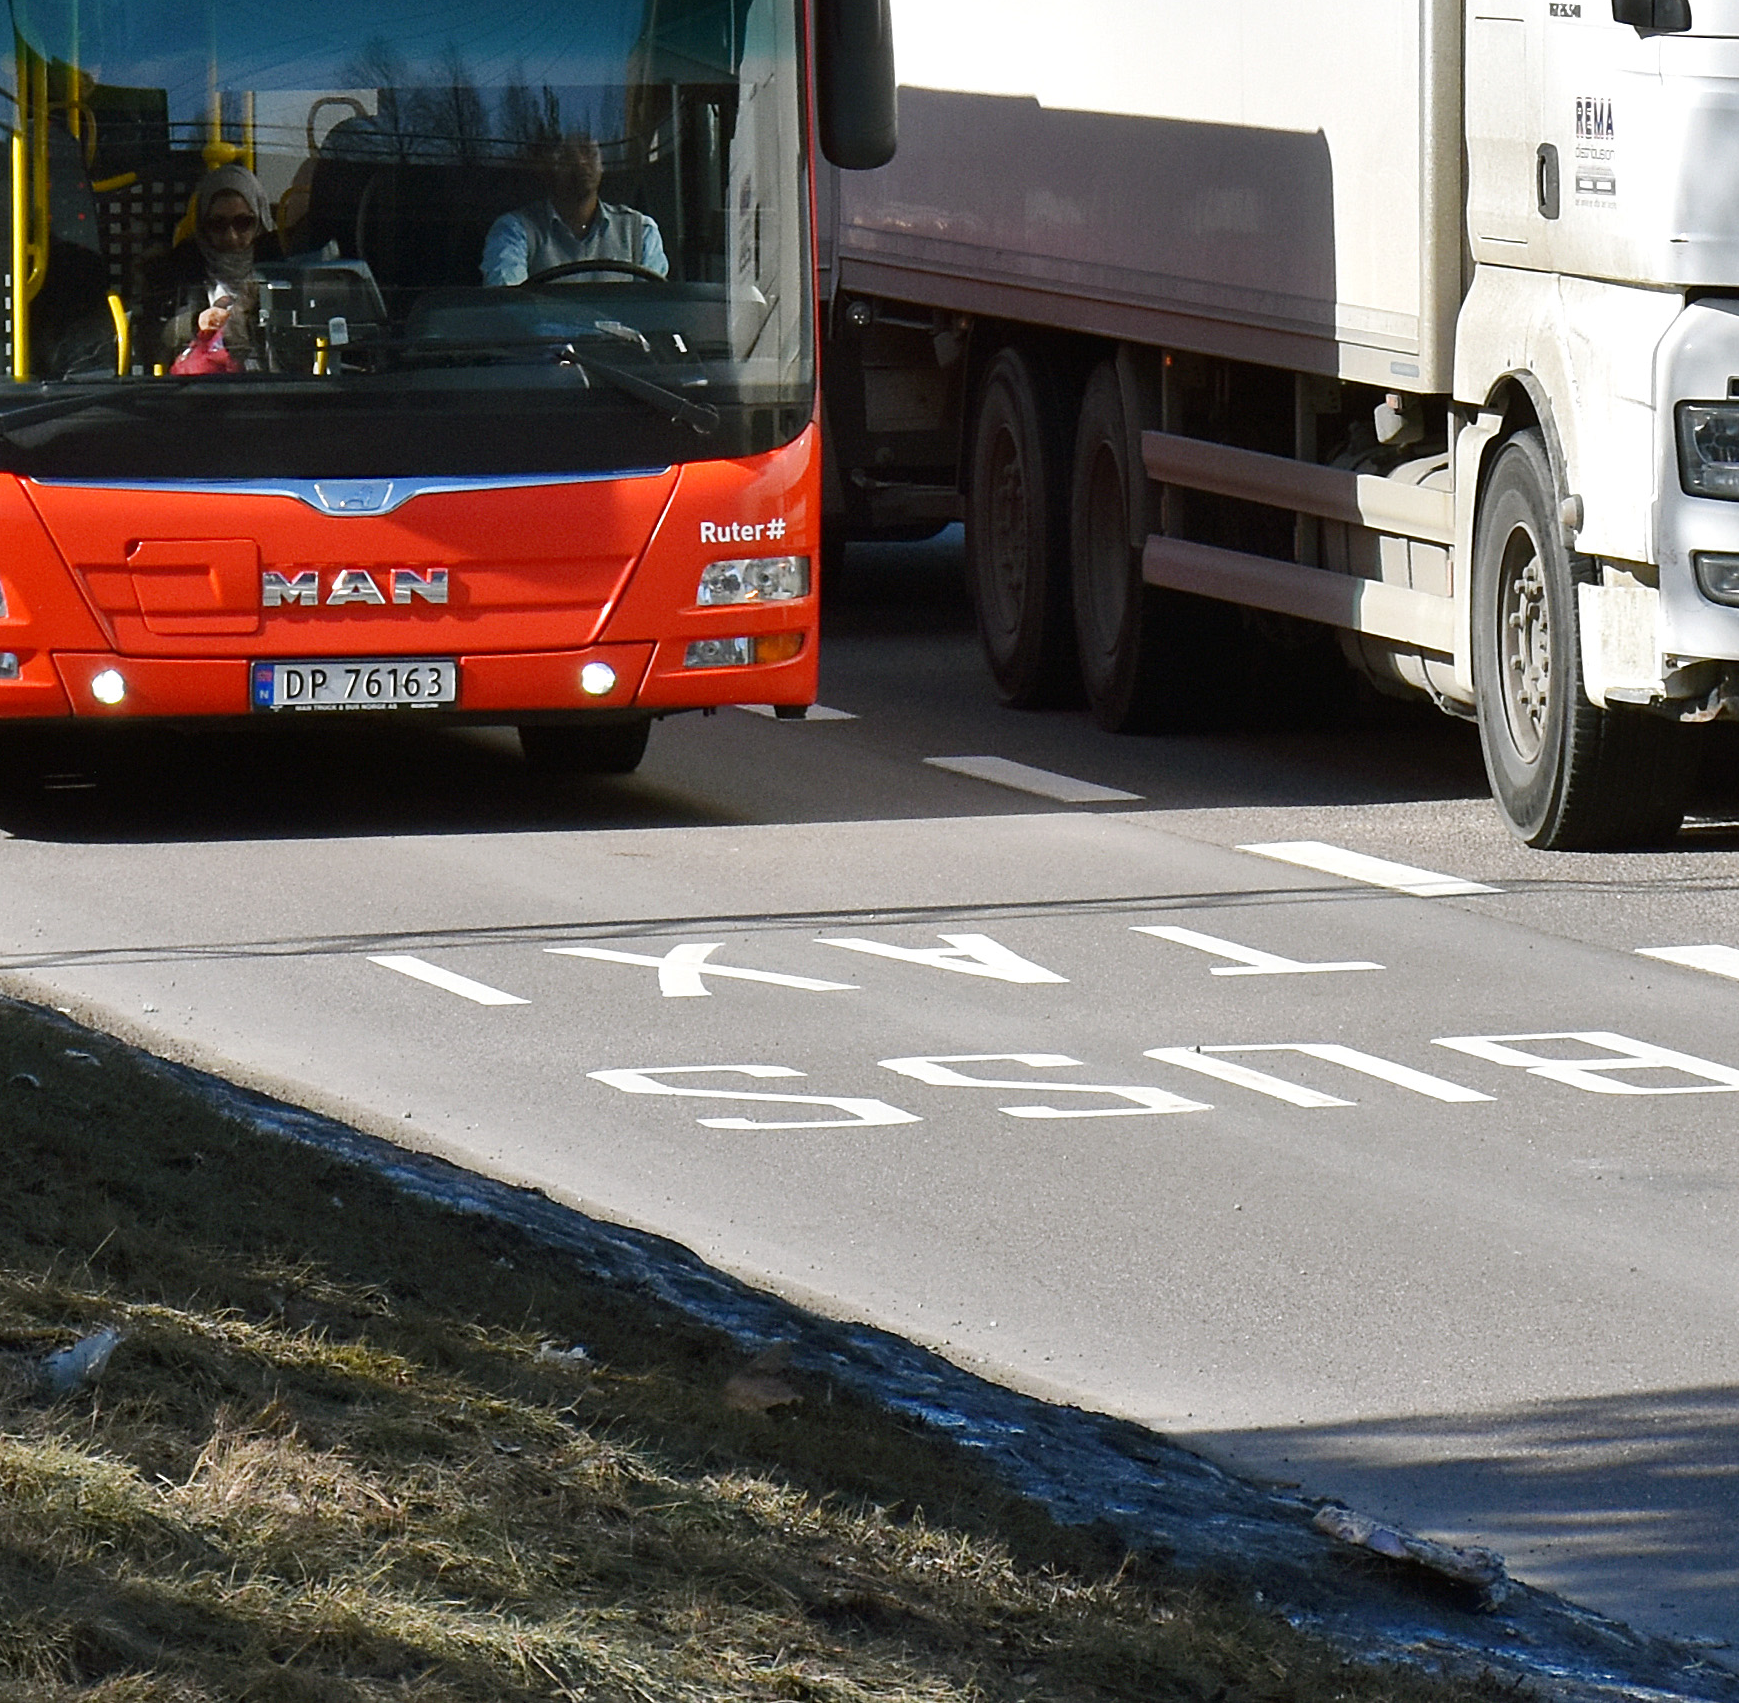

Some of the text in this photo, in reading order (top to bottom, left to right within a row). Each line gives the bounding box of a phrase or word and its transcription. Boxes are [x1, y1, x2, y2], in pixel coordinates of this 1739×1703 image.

[1576, 96, 1614, 140] REMA
[262, 567, 449, 607] MAN
[283, 666, 443, 700] DP 76163
[364, 925, 1386, 1006] TAXI
